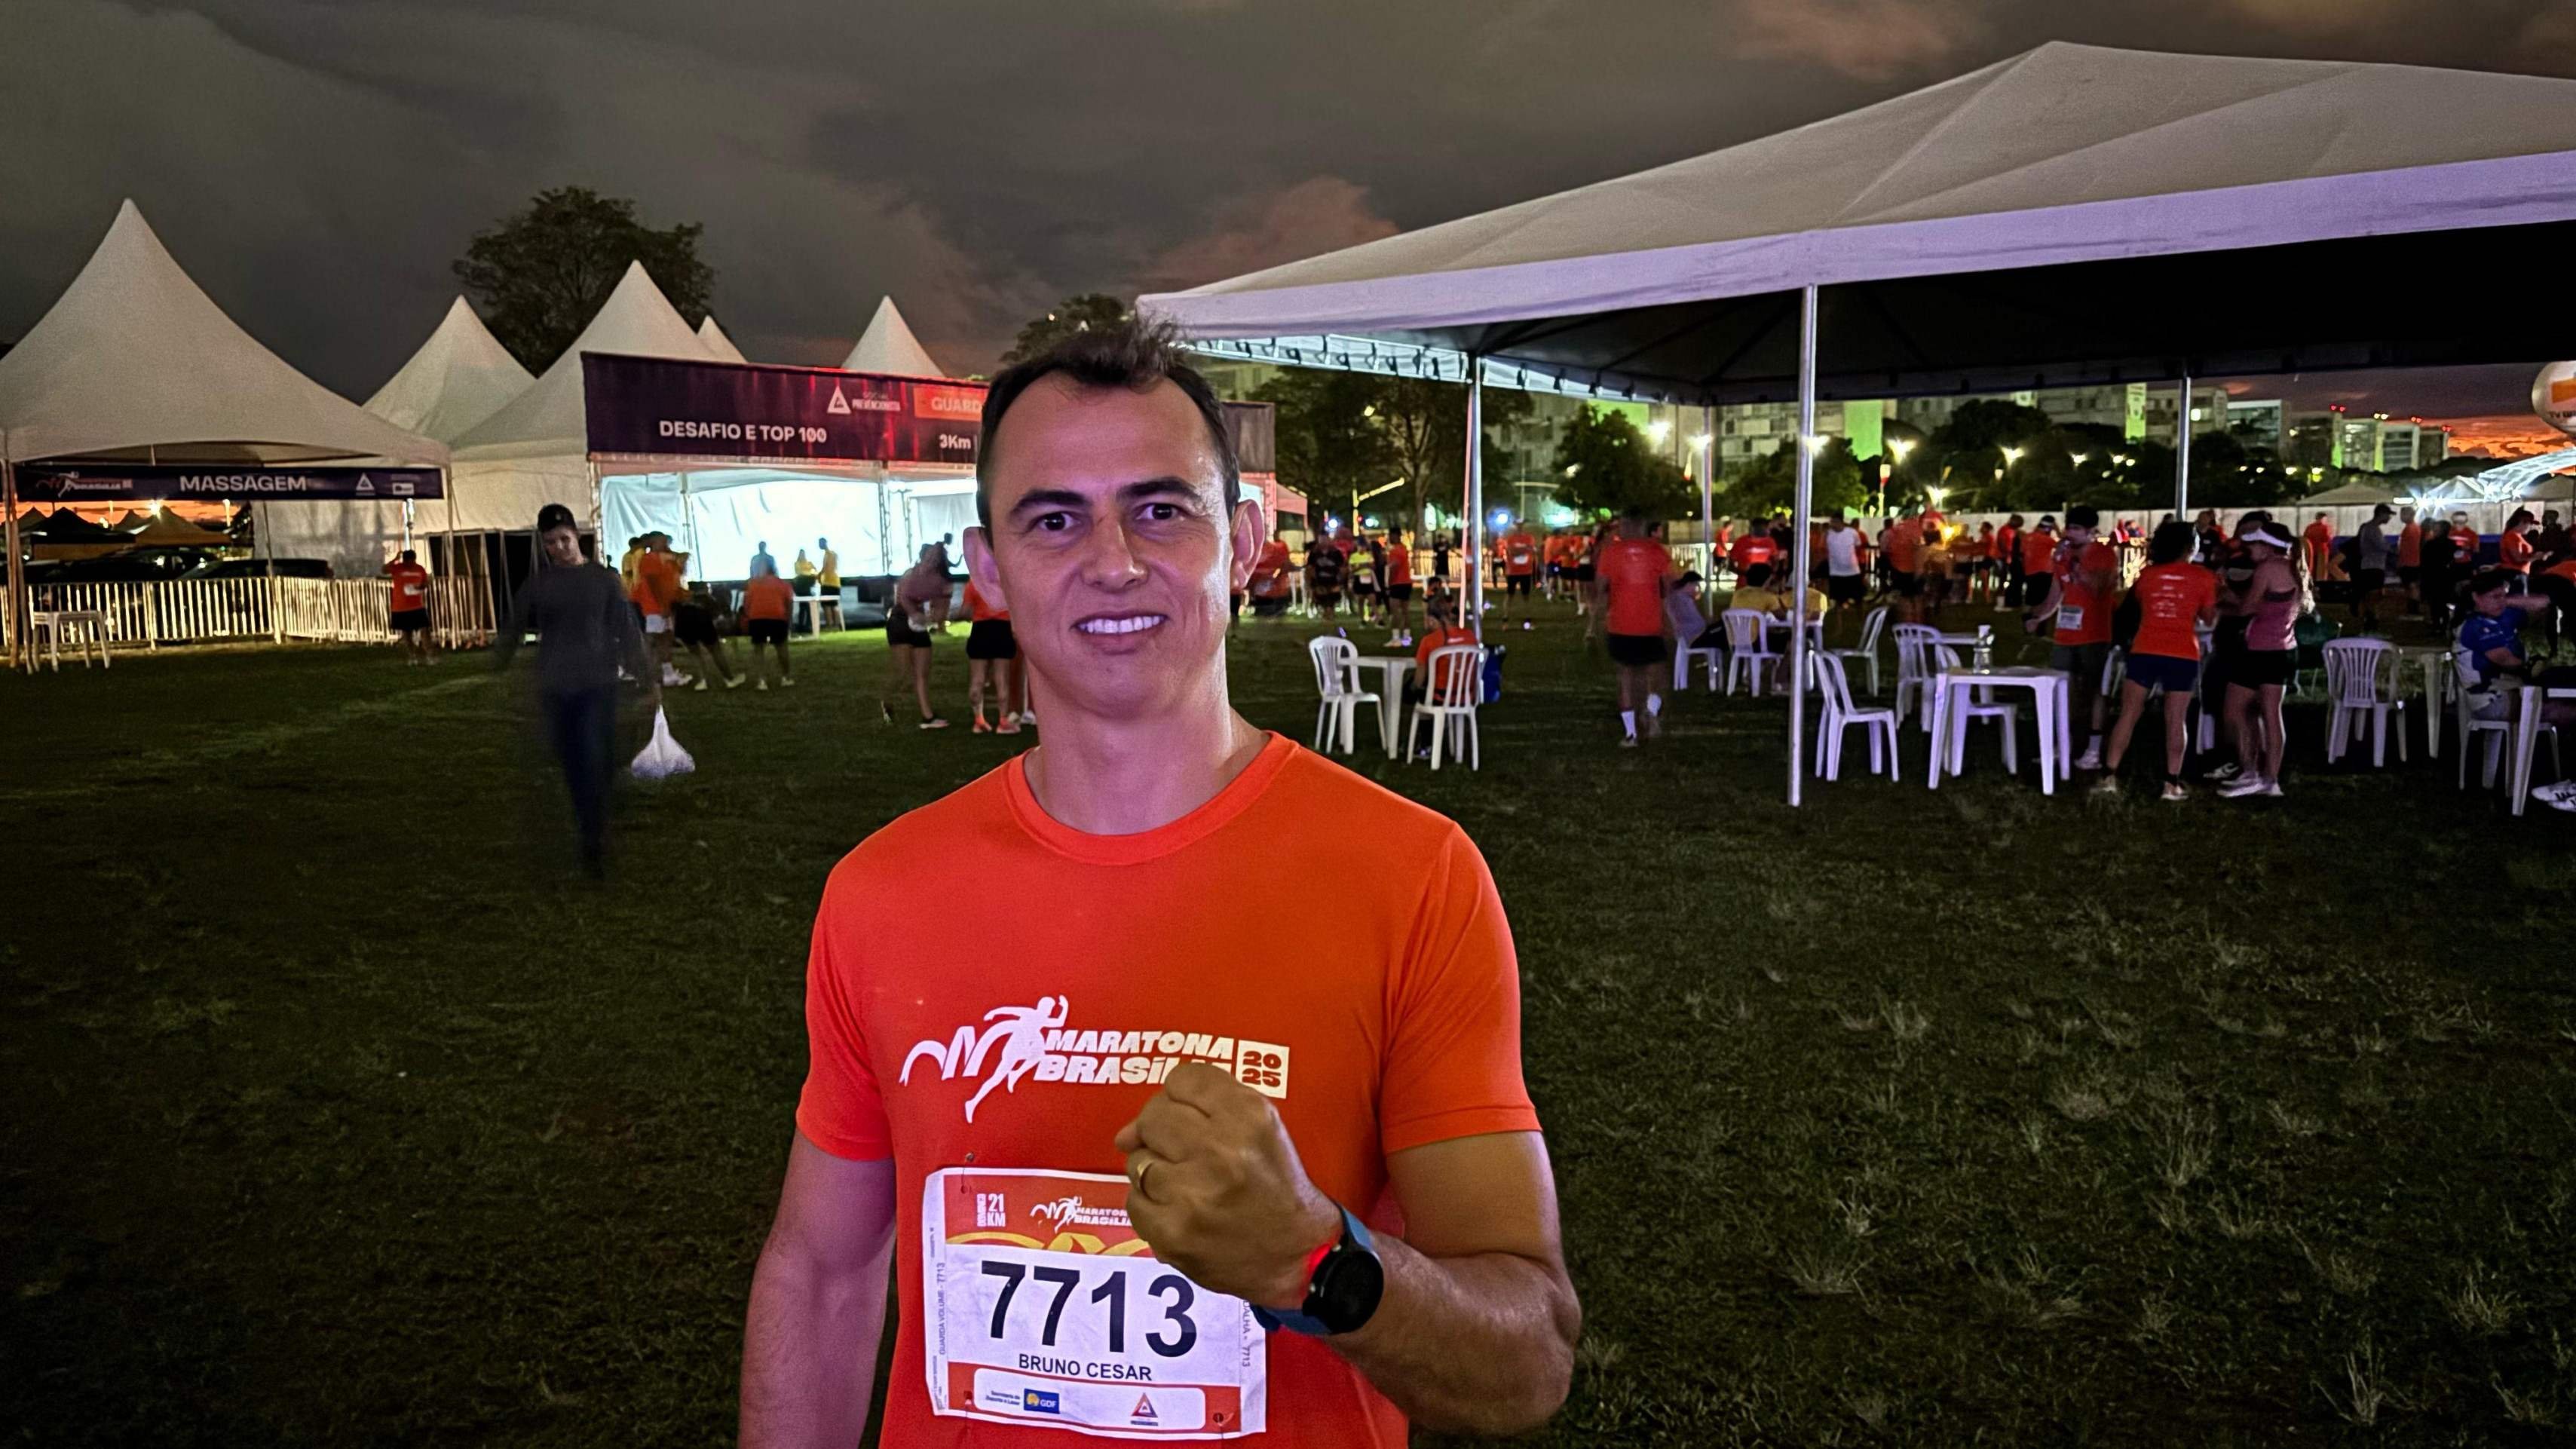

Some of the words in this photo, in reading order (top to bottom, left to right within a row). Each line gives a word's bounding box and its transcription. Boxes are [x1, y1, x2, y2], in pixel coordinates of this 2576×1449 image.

[931, 397, 983, 412] GUARD
[659, 420, 742, 440] DESAFIO
[745, 424, 757, 440] E
[758, 425, 795, 443] TOP
[798, 427, 828, 443] 100
[939, 433, 972, 449] 3Km
[179, 475, 307, 492] MASSAGEM
[1043, 1030, 1235, 1060] MARATONA
[1033, 1055, 1232, 1084] BRASÍL
[1242, 1050, 1282, 1070] 20
[1241, 1068, 1282, 1088] 25
[988, 1193, 1004, 1212] 21
[1076, 1207, 1129, 1218] MARATON
[987, 1212, 1006, 1227] KM
[936, 1262, 945, 1283] 7713
[980, 1260, 1198, 1358] 7713
[1242, 1300, 1251, 1334] DALHA
[1018, 1353, 1081, 1376] BRUNO
[1086, 1362, 1152, 1381] CESAR
[1242, 1346, 1251, 1368] 7713
[1040, 1399, 1058, 1408] GDF
